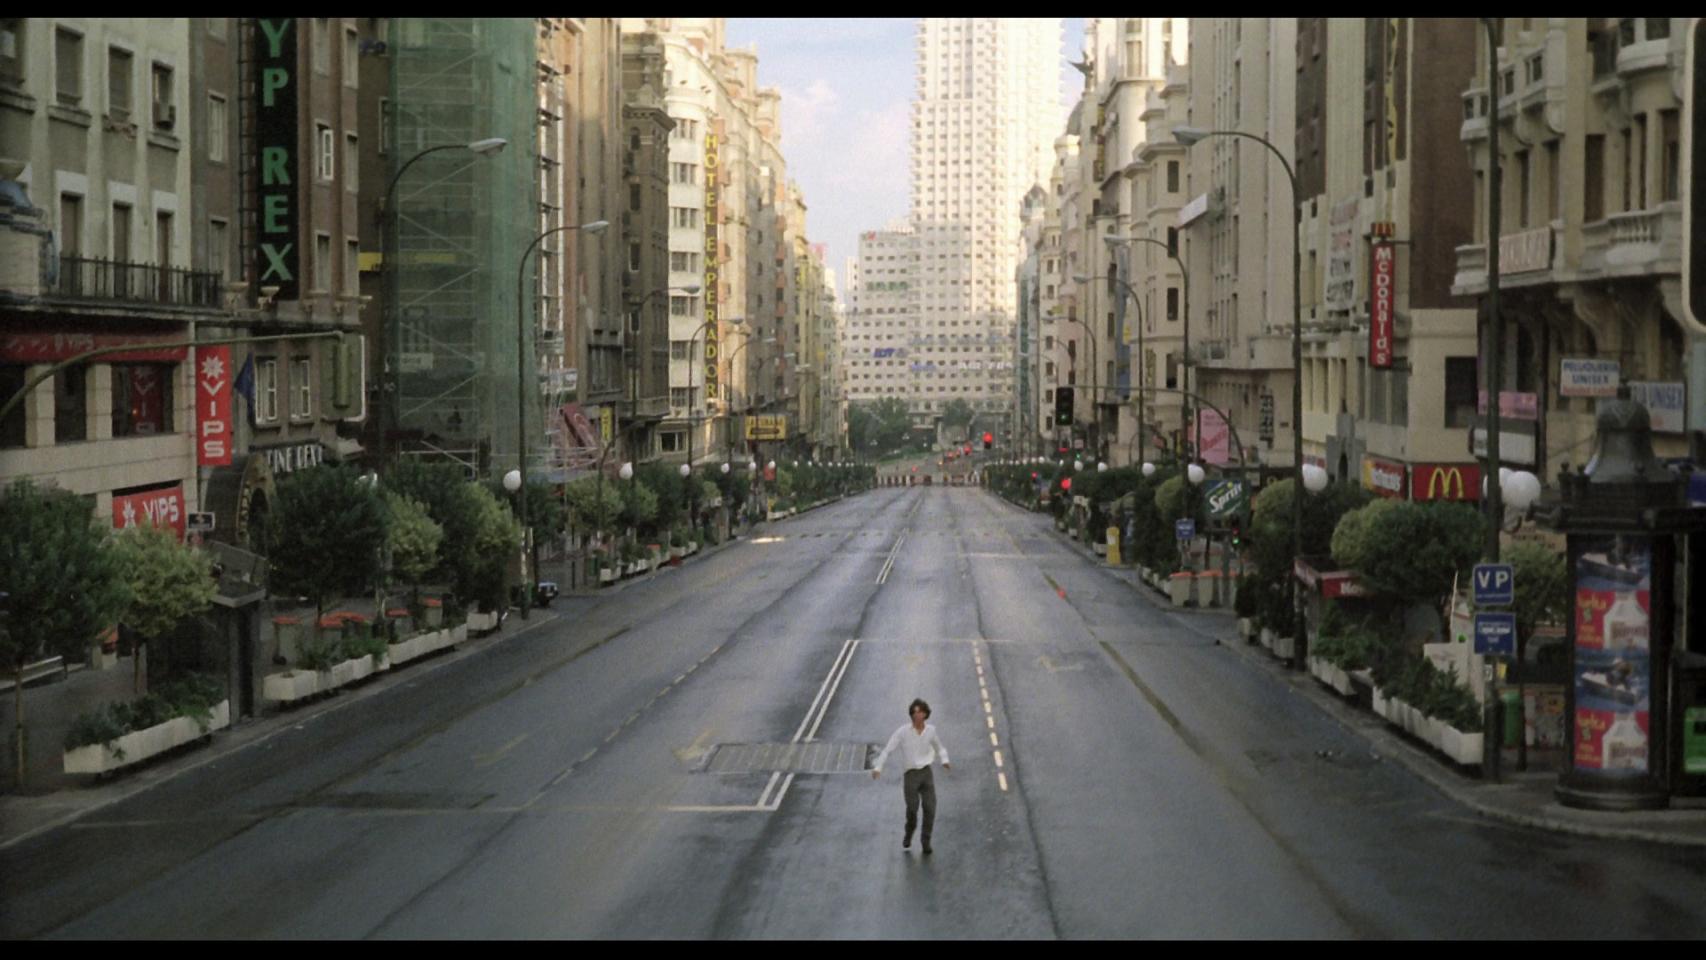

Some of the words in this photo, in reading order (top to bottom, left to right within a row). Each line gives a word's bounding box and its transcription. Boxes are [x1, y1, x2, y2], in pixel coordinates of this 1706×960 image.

[260, 146, 293, 281] REX
[704, 134, 718, 225] HOTEL
[704, 237, 718, 398] EMPERADOR
[202, 380, 225, 458] VIPS
[143, 495, 180, 526] VIPS
